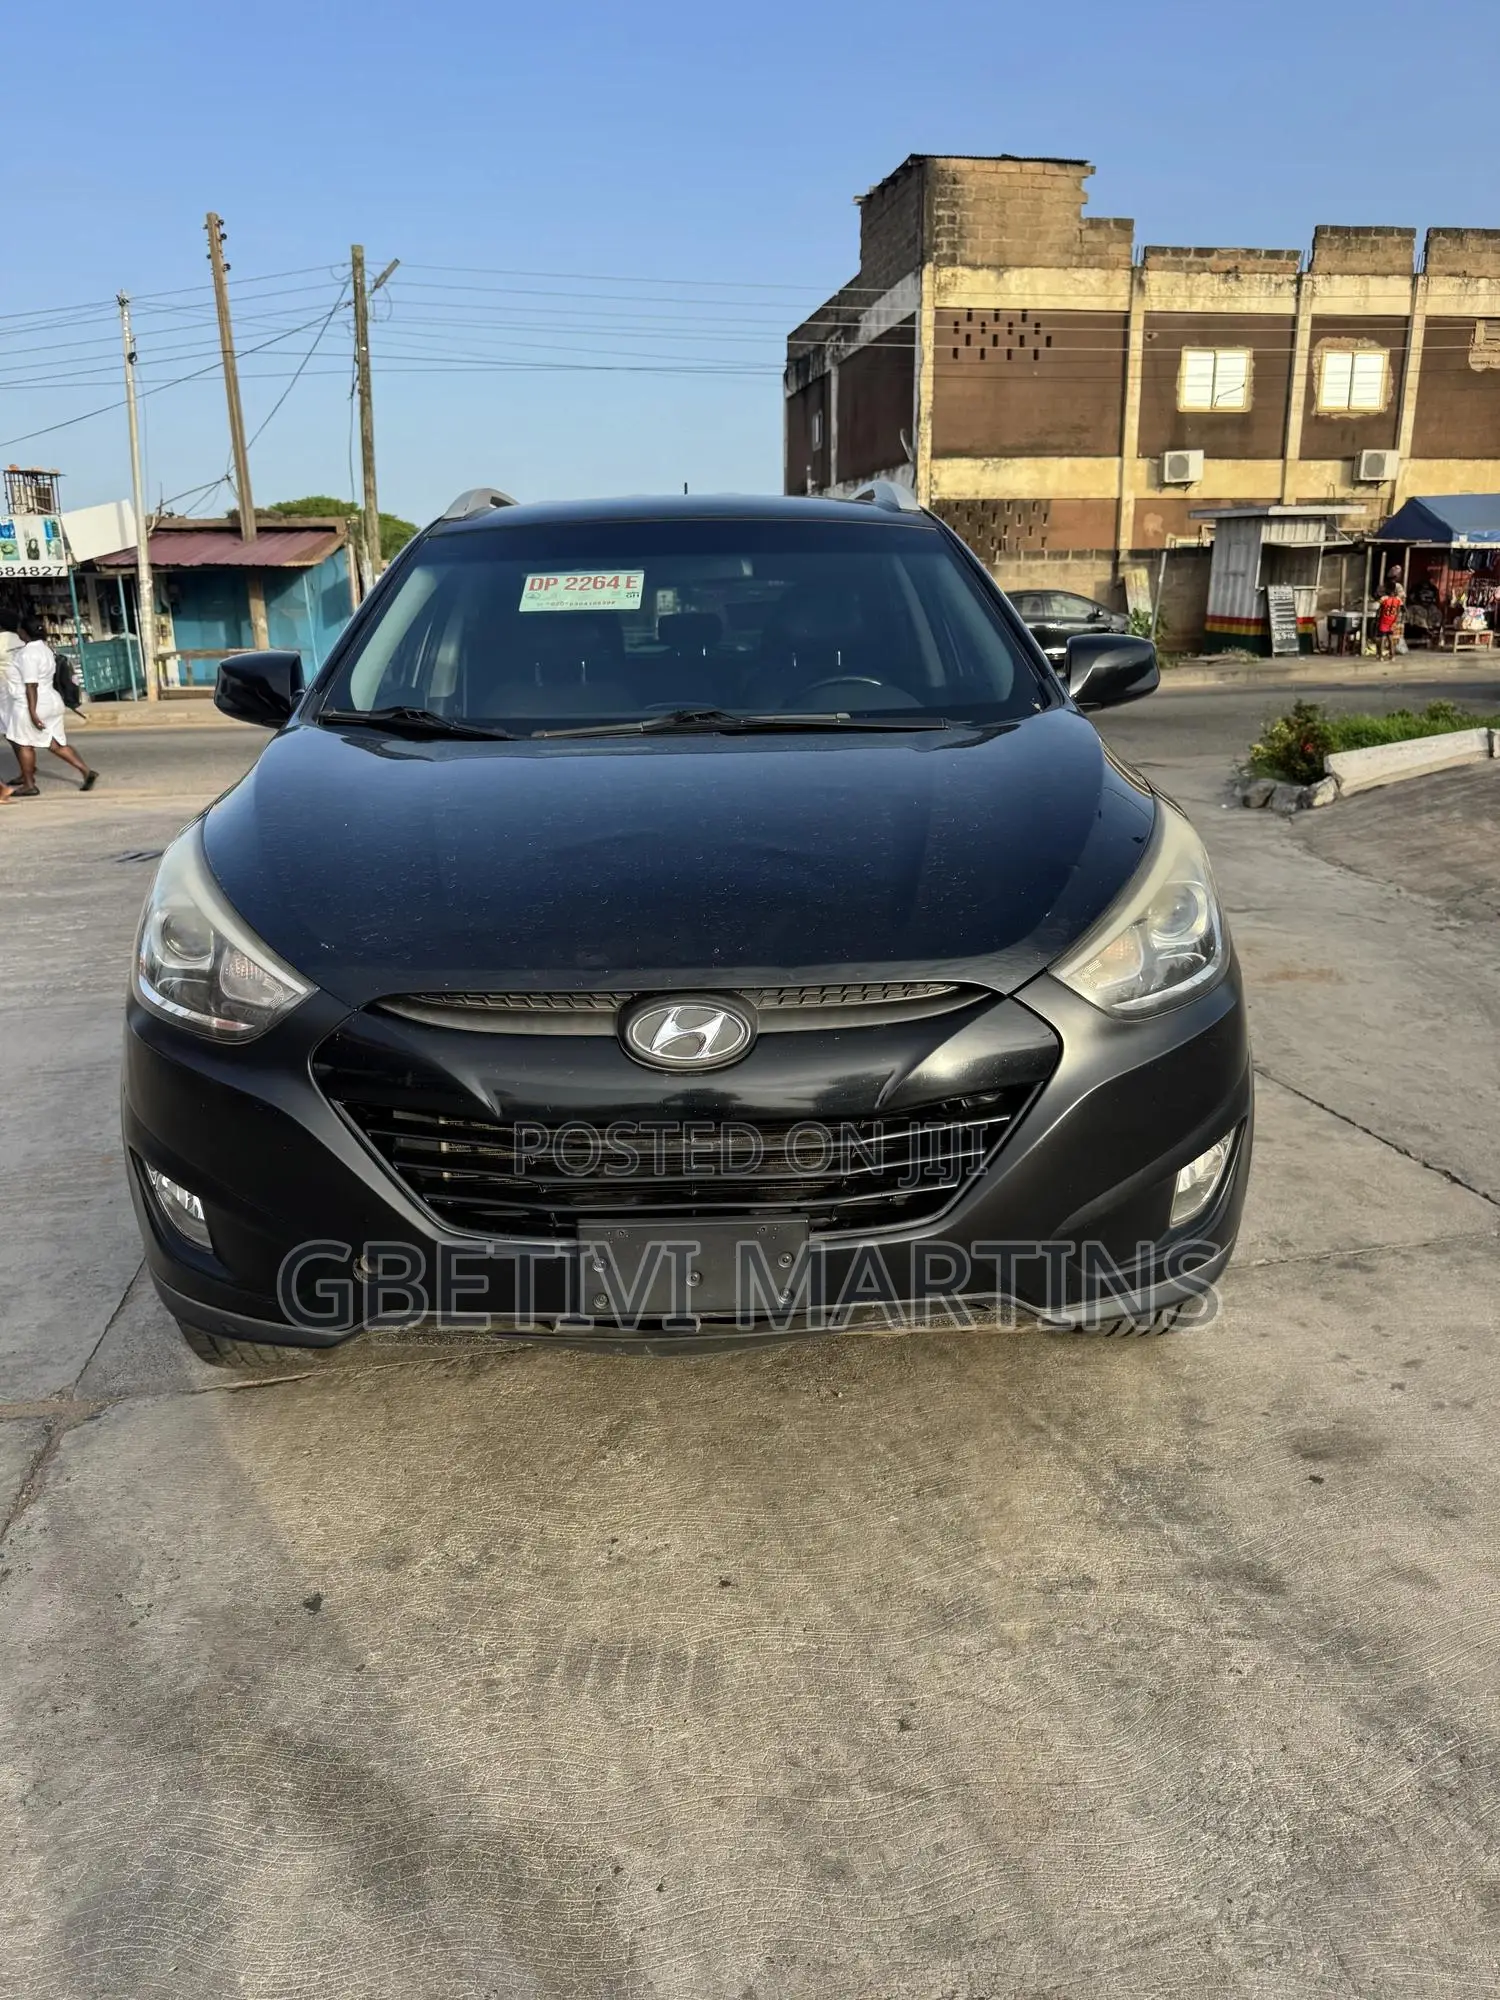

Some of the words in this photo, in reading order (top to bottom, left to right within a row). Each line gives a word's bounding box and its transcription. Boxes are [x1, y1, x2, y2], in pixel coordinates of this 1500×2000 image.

[528, 577, 559, 591] DP
[564, 575, 620, 591] 2264
[626, 575, 639, 589] E
